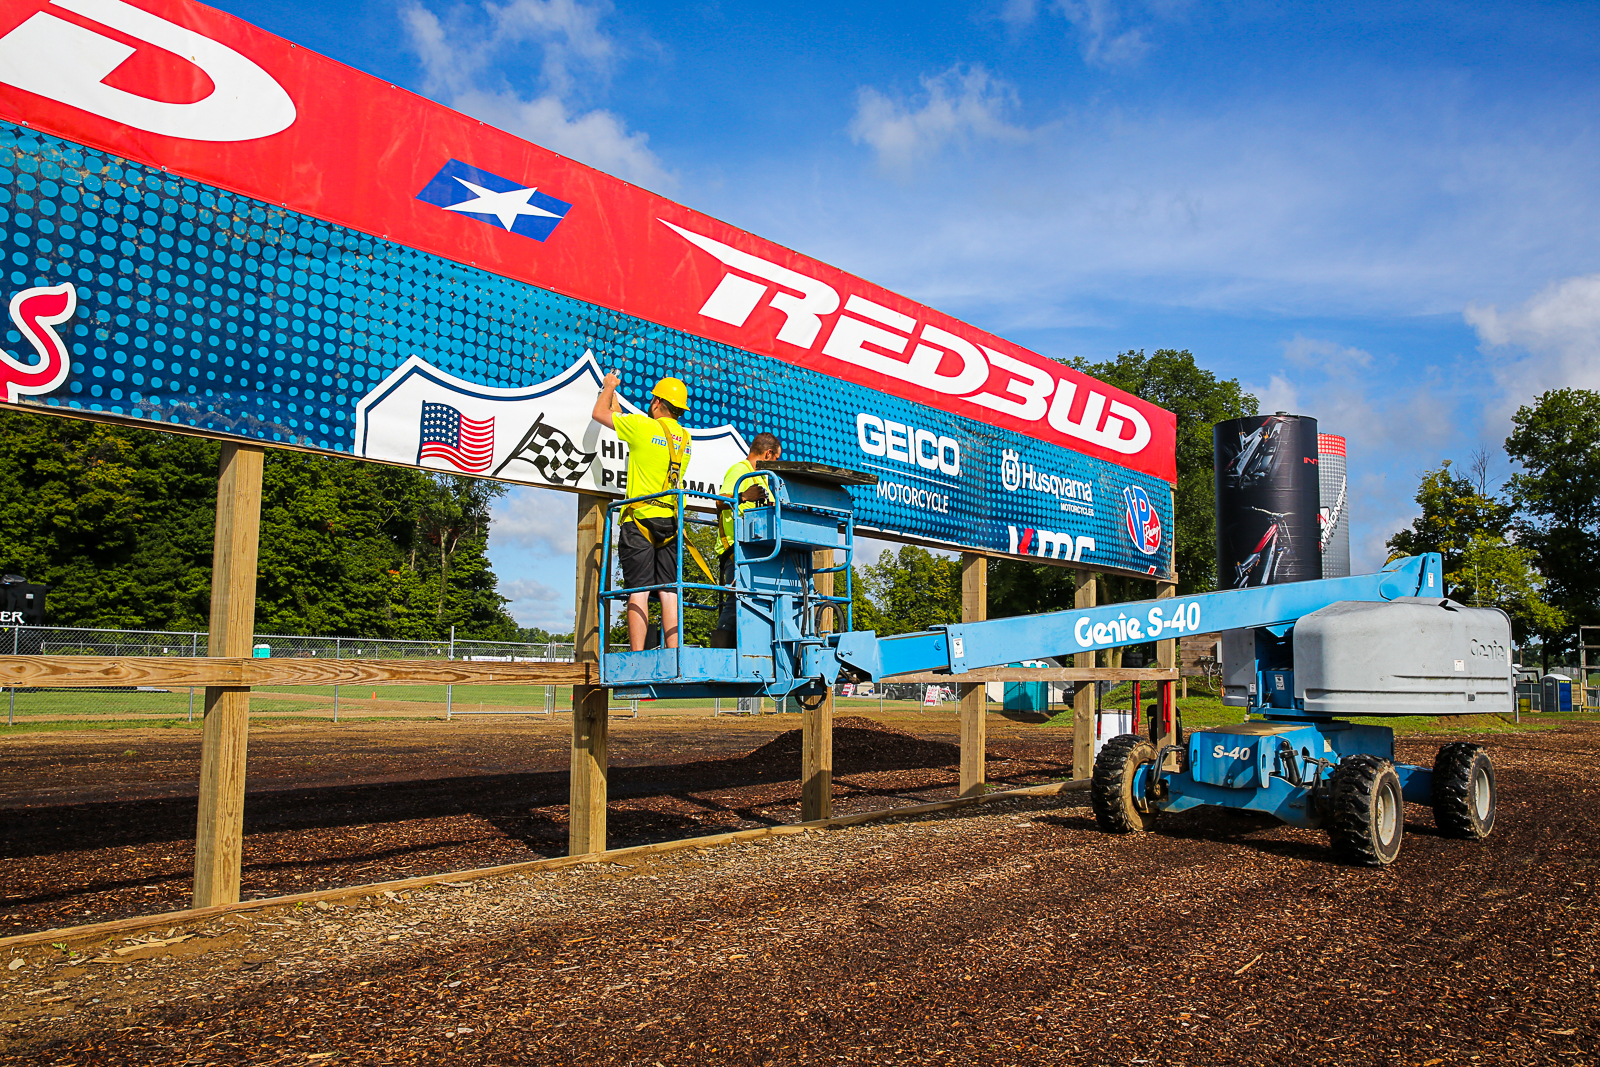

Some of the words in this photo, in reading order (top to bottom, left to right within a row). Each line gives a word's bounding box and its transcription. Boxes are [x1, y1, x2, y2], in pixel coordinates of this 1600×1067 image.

[656, 217, 1152, 455] REDBUD
[857, 412, 960, 477] GEICO
[877, 481, 949, 513] MOTORCYCLE
[1022, 462, 1093, 502] Husqvarna
[1060, 502, 1095, 517] MOTORCYCLES
[1074, 612, 1142, 648] Genie
[1147, 602, 1201, 637] S-40
[1470, 638, 1505, 660] Genie
[1213, 745, 1251, 761] S-40
